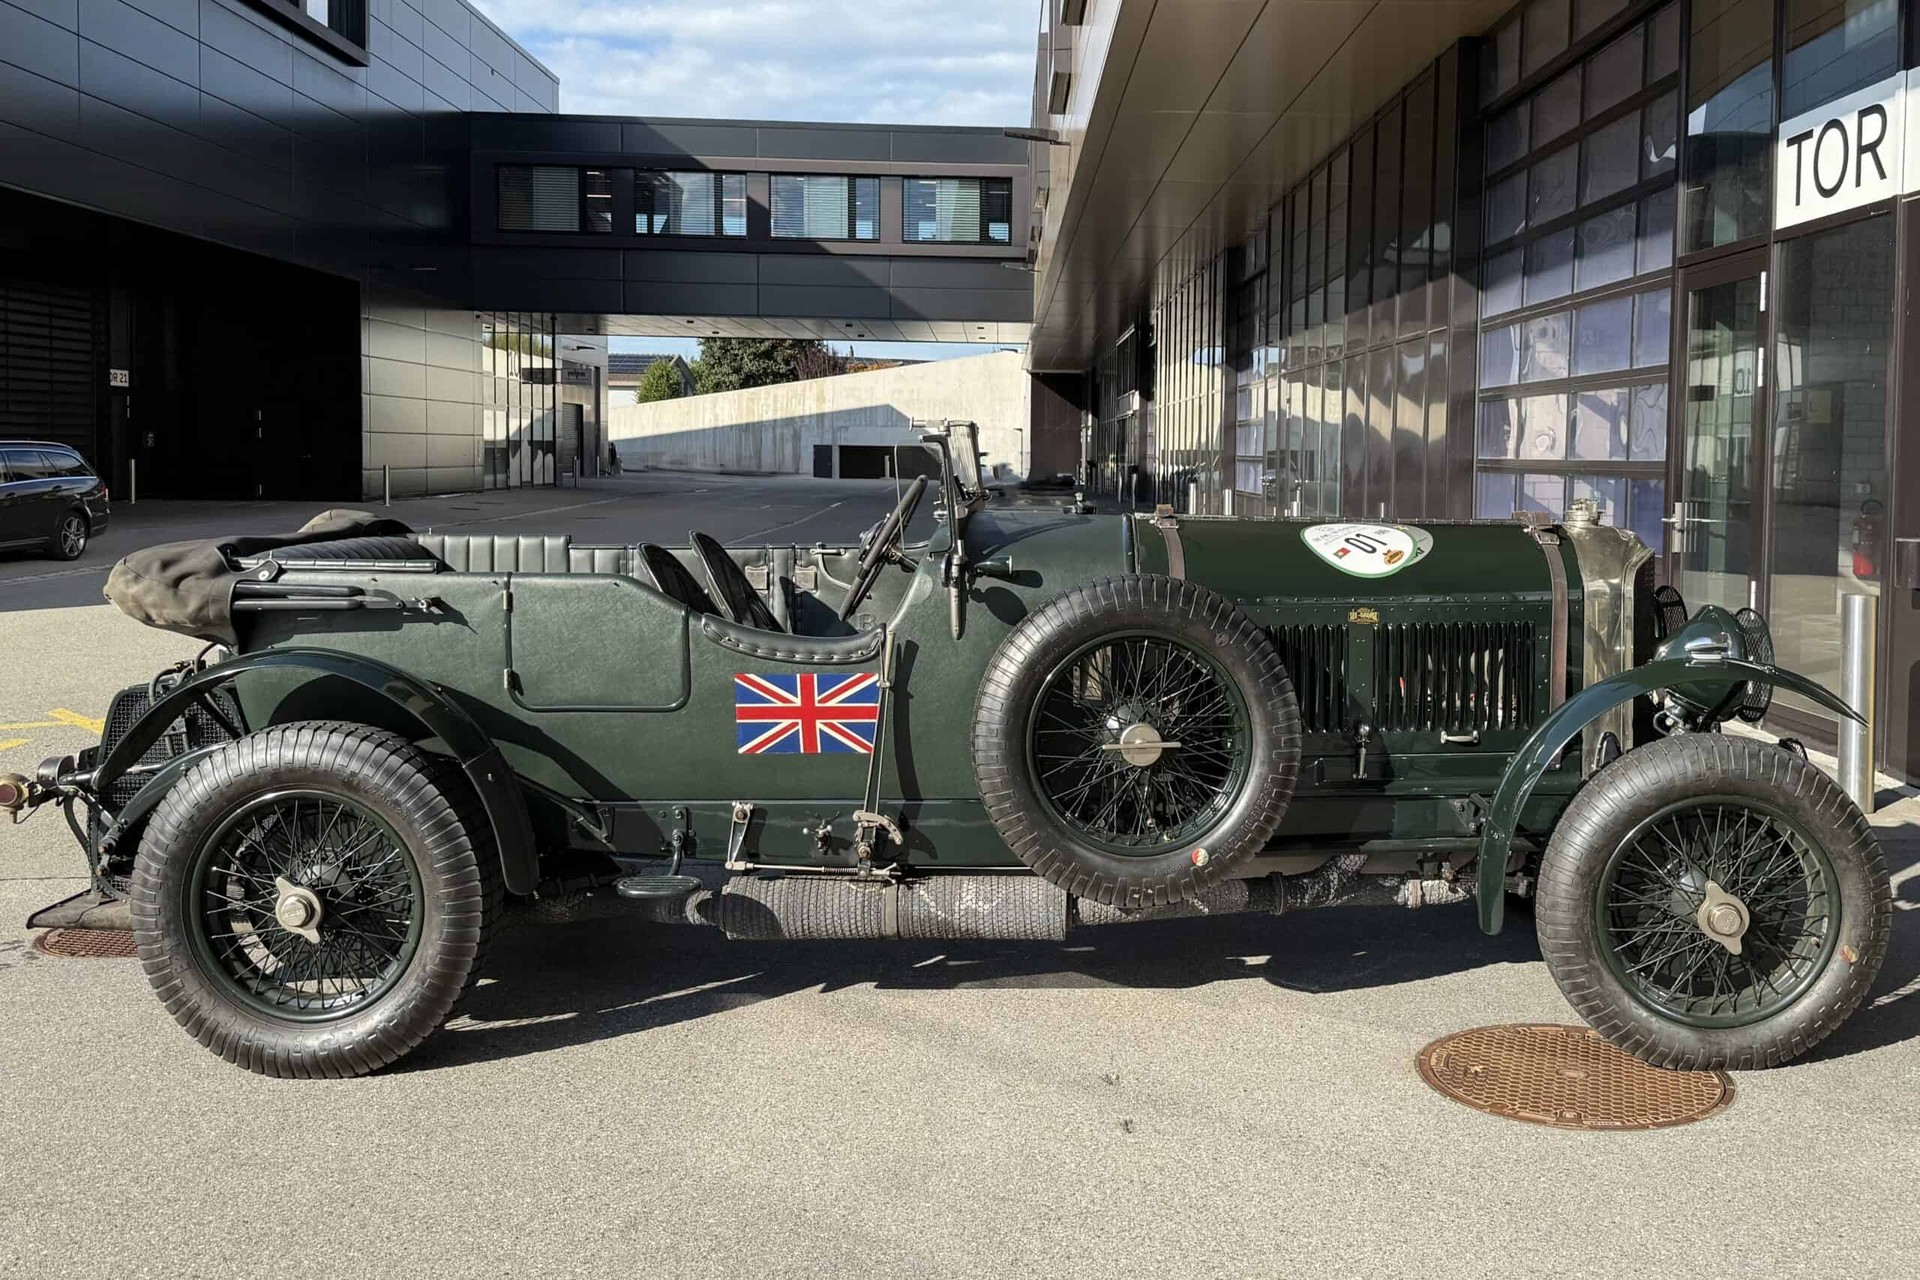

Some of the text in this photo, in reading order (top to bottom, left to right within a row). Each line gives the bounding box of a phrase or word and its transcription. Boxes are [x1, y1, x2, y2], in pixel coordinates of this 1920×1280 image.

[1786, 103, 1888, 207] TOR
[119, 372, 128, 384] 21
[1344, 533, 1388, 554] 01
